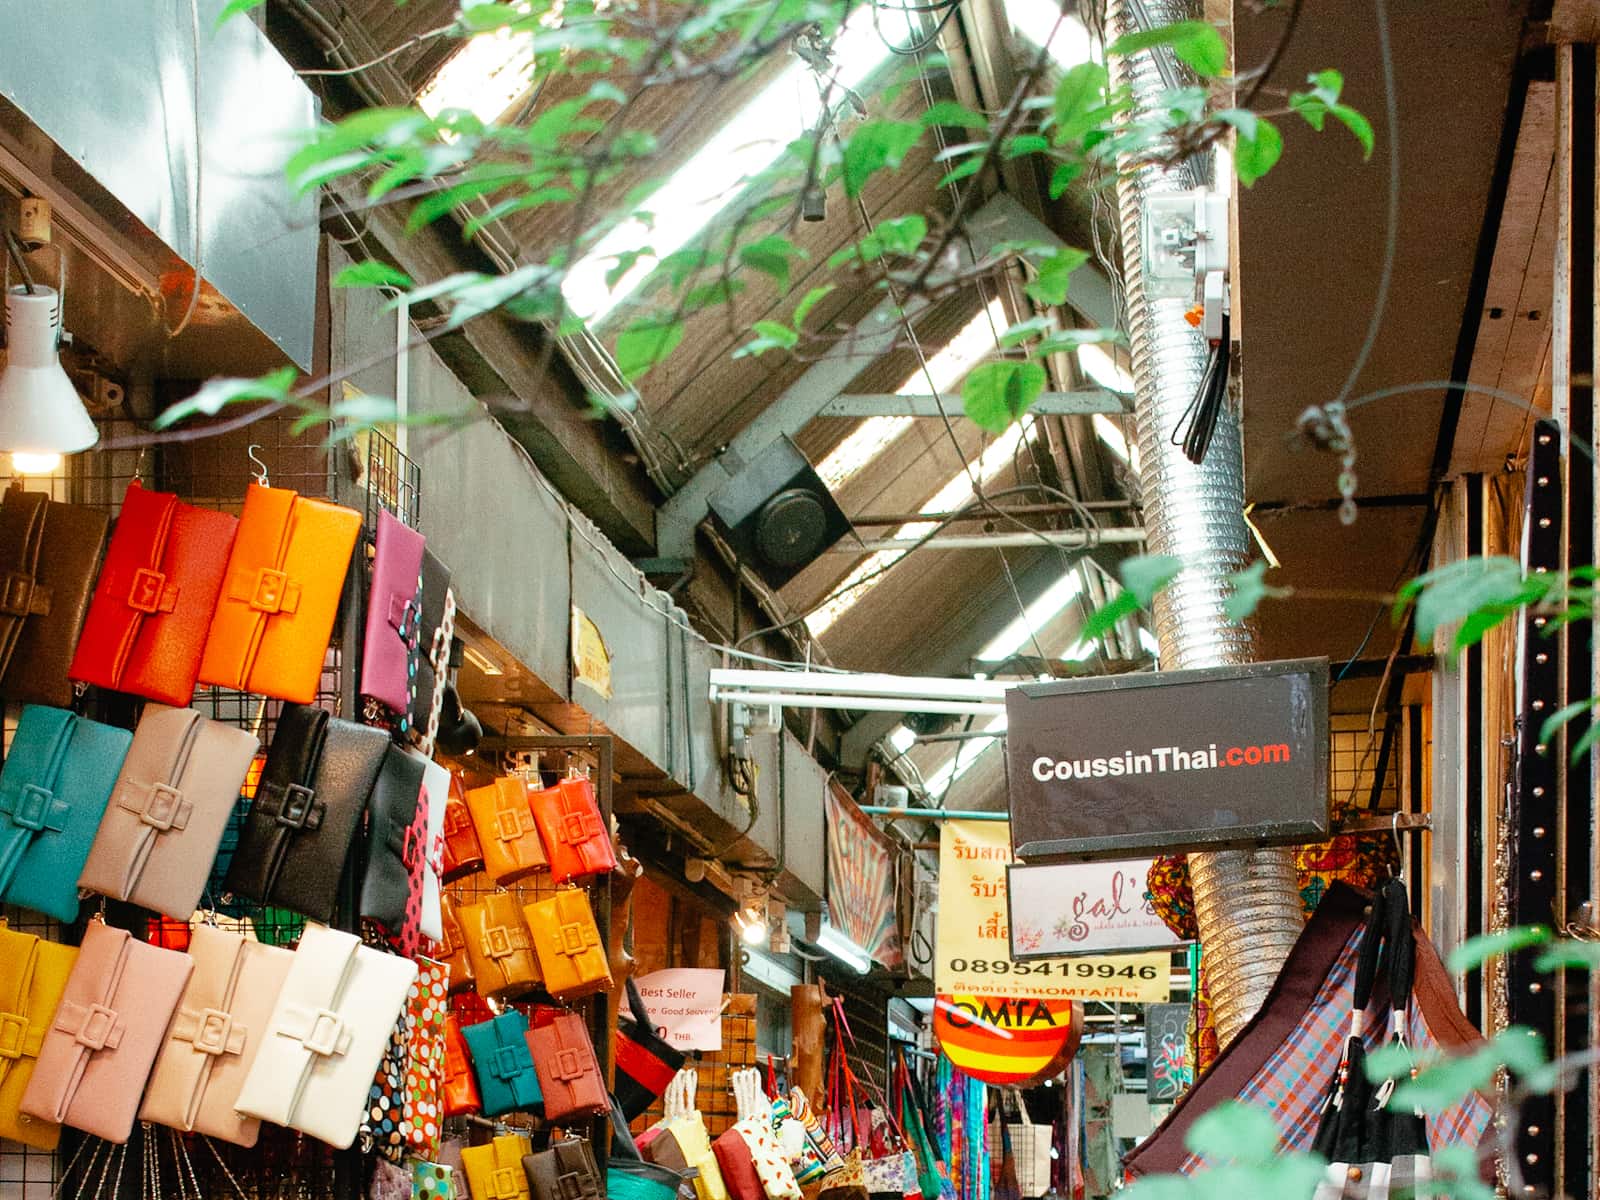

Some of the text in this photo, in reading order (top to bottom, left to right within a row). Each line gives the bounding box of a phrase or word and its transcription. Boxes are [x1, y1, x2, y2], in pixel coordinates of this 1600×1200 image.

[1032, 743, 1291, 782] CoussinThai.com
[950, 958, 1157, 980] 0895419946
[641, 988, 696, 999] Best Seller
[661, 1007, 684, 1015] Good
[946, 1000, 1057, 1028] OMTA
